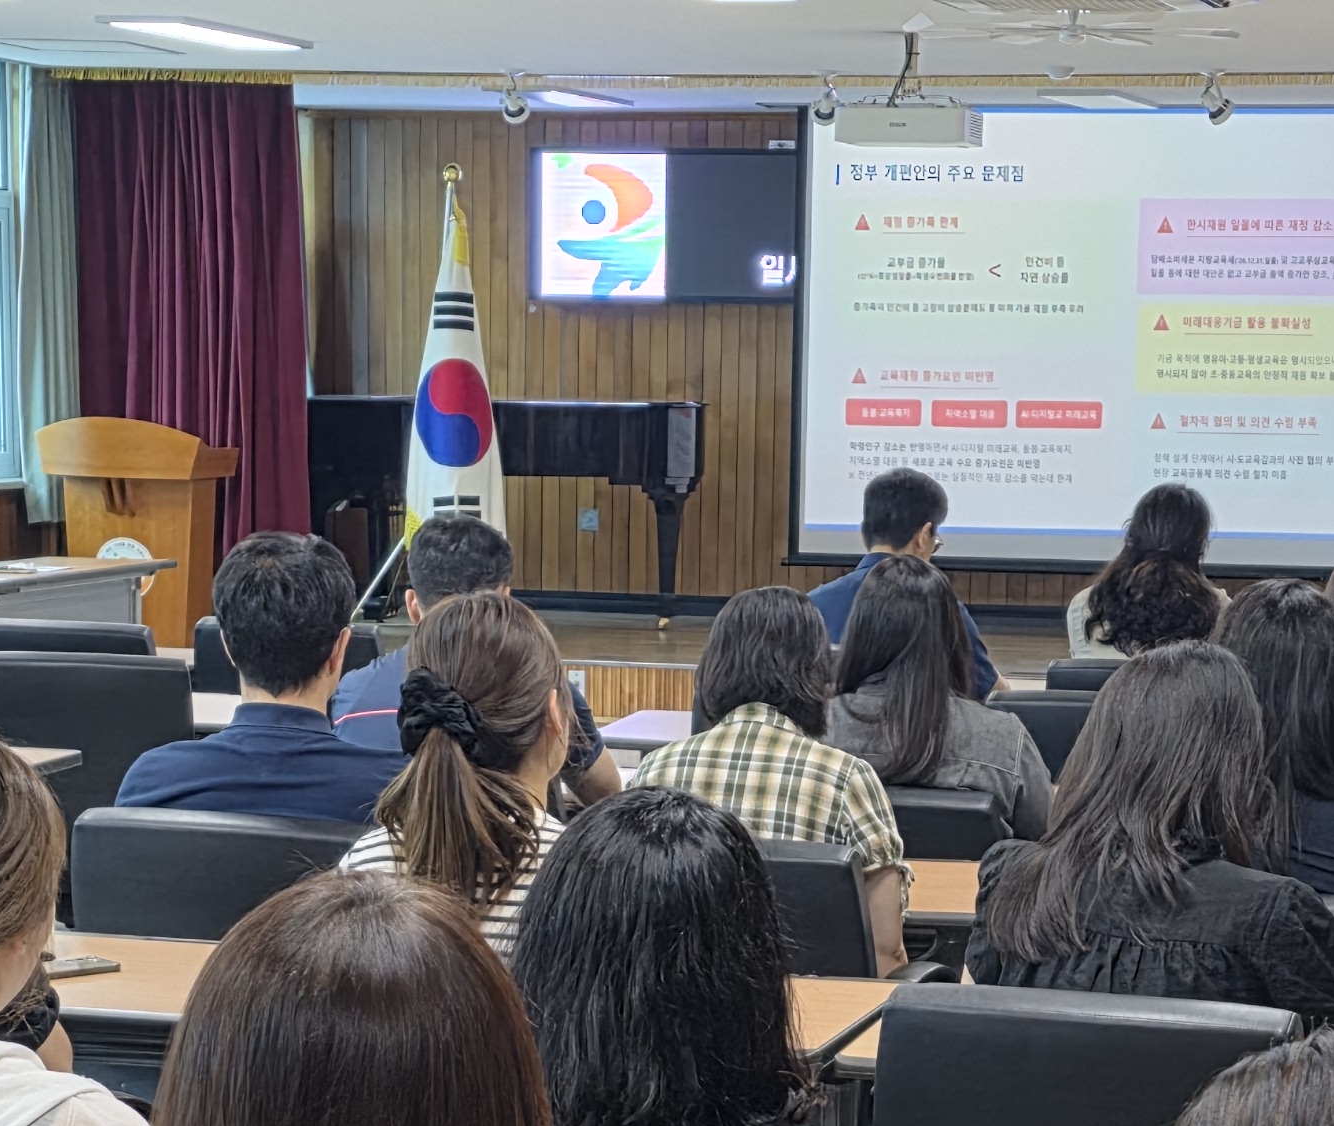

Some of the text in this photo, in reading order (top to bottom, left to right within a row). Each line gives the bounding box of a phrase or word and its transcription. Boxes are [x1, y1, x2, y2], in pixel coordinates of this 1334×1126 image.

[850, 164, 1024, 182] 정부 개편안의 주요 문제점
[1187, 219, 1226, 231] 한시재원
[1264, 219, 1284, 231] 따른
[1288, 220, 1308, 232] 재정
[1314, 220, 1332, 232] 감소
[1183, 316, 1242, 328] 미래대응기금
[1271, 318, 1311, 330] 불확실성
[1158, 354, 1172, 364] 기금
[1214, 416, 1232, 428] 협의
[1237, 416, 1246, 428] 및
[1250, 416, 1270, 428] 의견
[1274, 416, 1294, 428] 수렴
[1298, 417, 1318, 429] 부족
